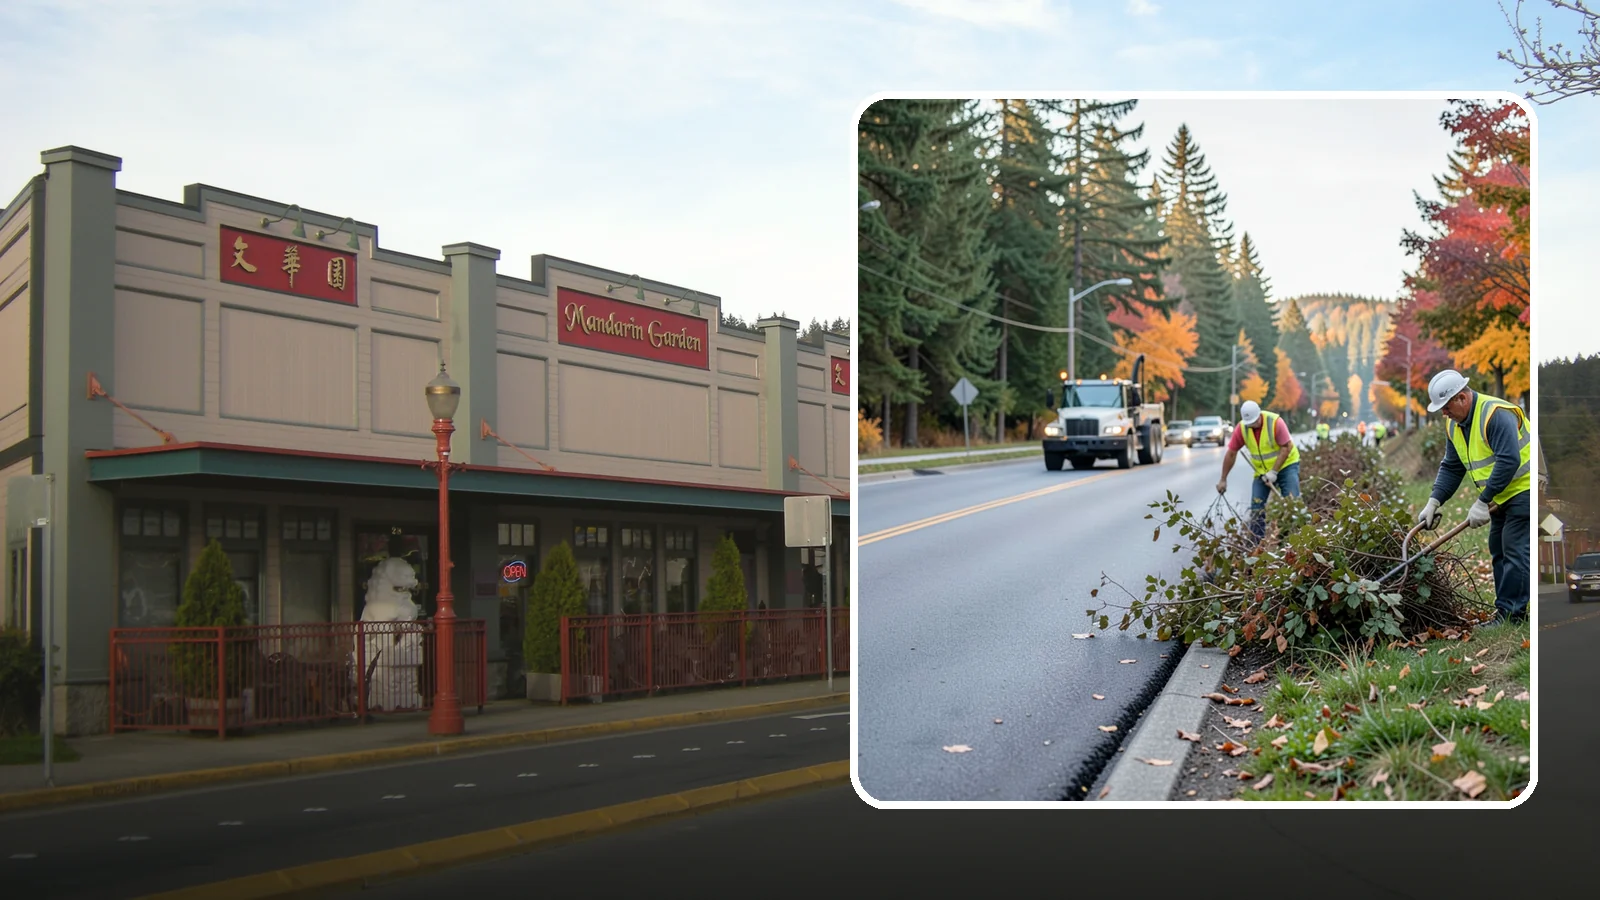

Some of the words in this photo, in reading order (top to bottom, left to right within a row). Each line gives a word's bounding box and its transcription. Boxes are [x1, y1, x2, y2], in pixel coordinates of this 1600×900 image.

[231, 236, 346, 291] 文華園
[565, 302, 644, 340] Mandarin
[648, 320, 701, 352] Garden
[835, 363, 846, 386] 文
[503, 564, 527, 579] OPEN
